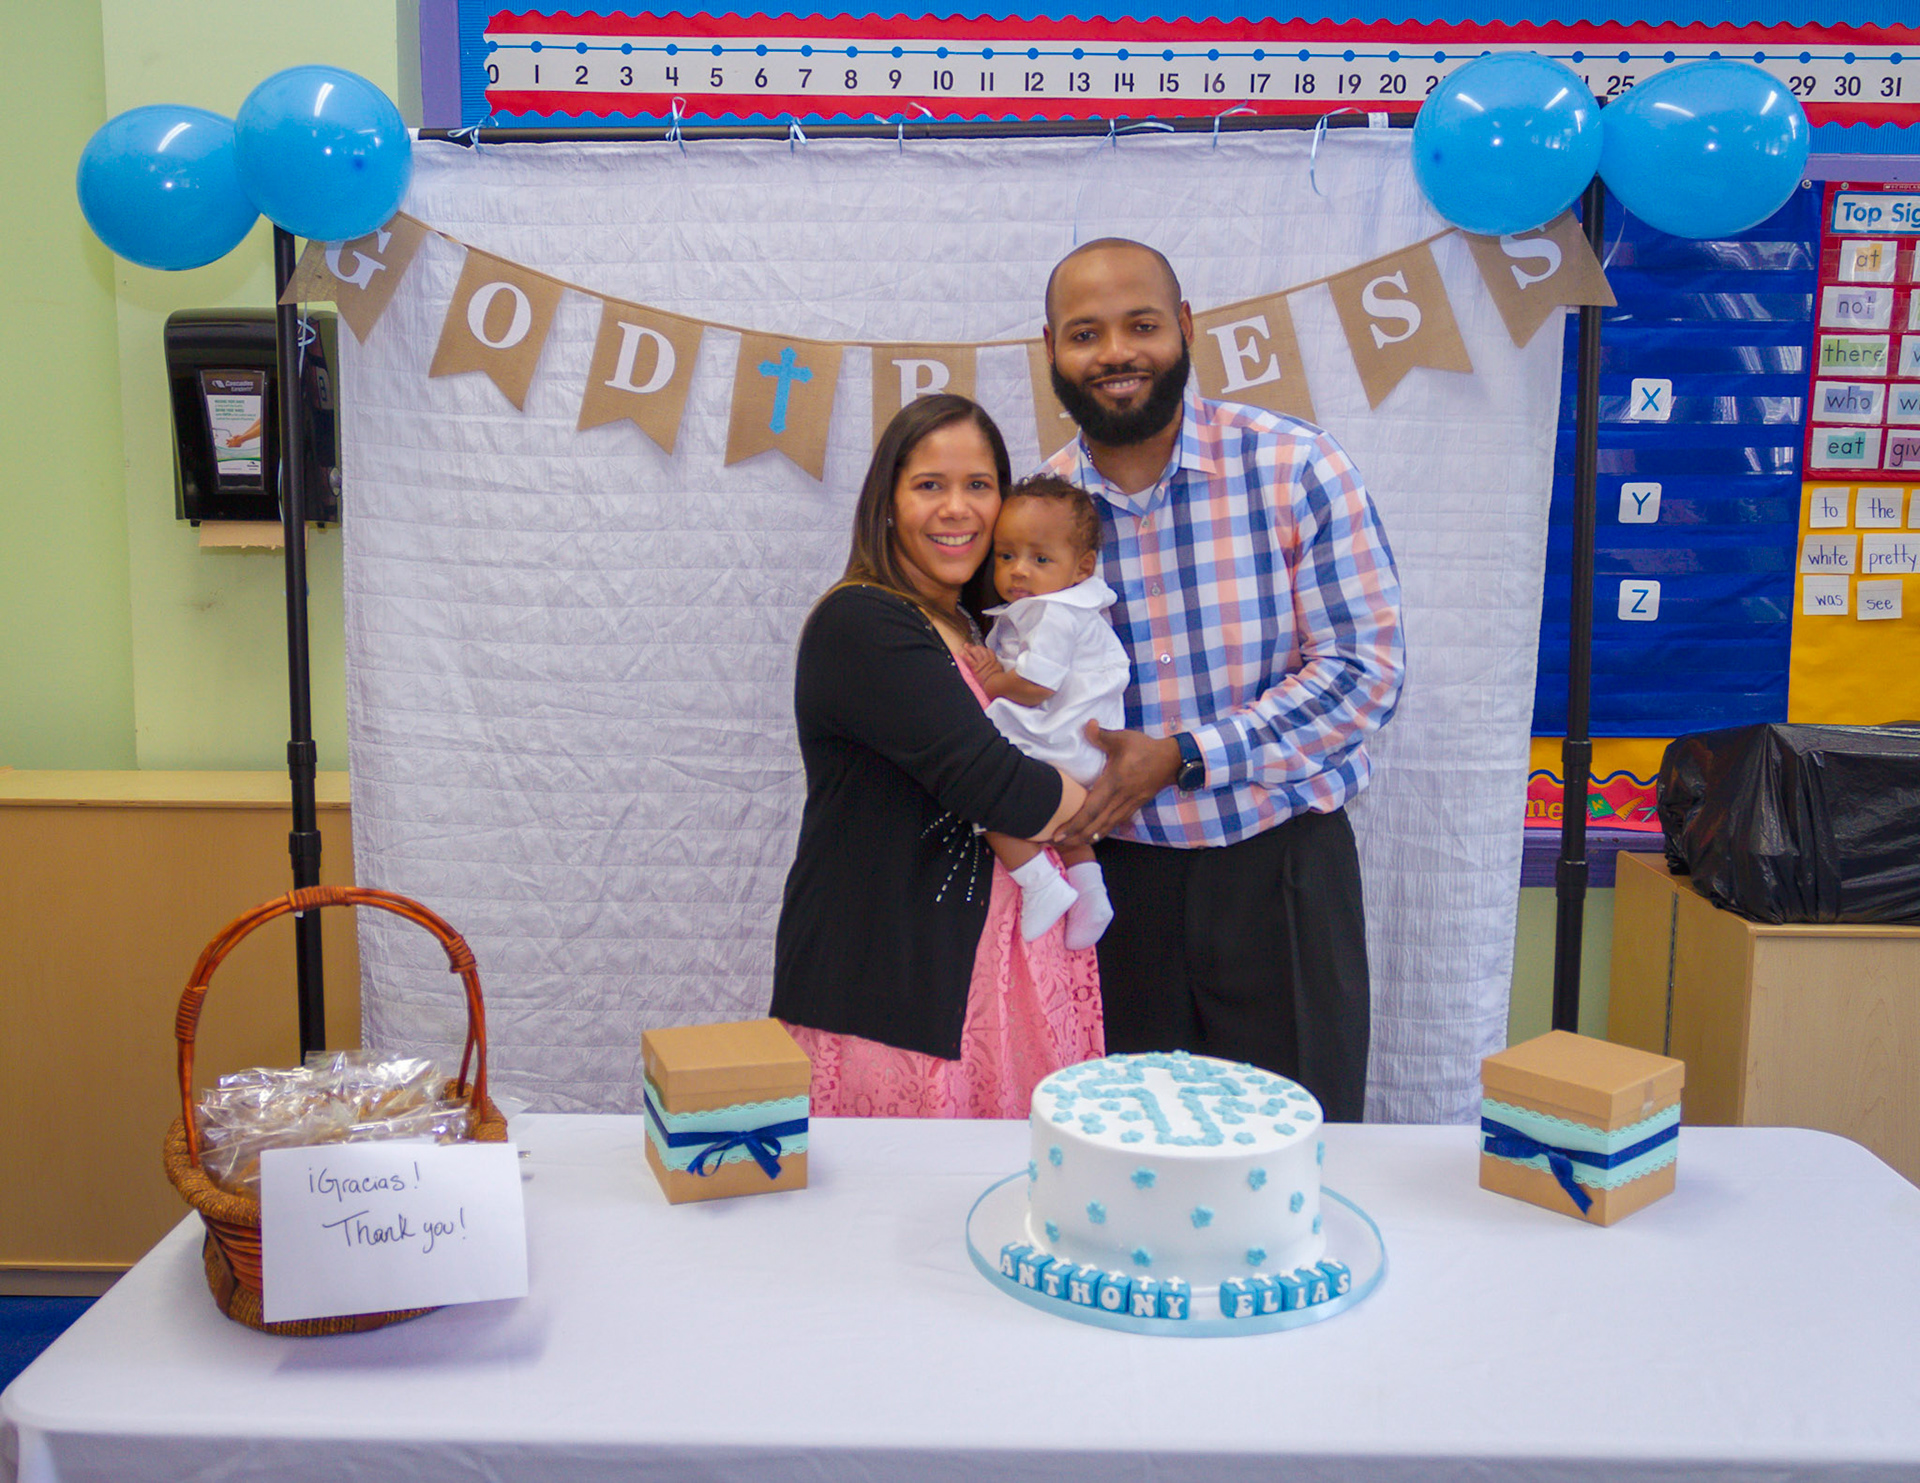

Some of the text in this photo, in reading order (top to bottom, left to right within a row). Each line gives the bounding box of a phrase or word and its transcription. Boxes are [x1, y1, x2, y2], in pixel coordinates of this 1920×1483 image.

[486, 63, 500, 85] 0
[534, 64, 540, 84] 1
[575, 65, 589, 85] 2
[619, 66, 634, 87] 3
[665, 66, 679, 87] 4
[710, 67, 723, 88] 5
[754, 67, 768, 88] 6
[798, 68, 812, 89] 7
[844, 69, 858, 90] 8
[889, 69, 902, 90] 9
[933, 70, 954, 91] 10
[980, 72, 994, 92] 11
[1025, 71, 1044, 92] 12
[1069, 72, 1091, 92] 13
[1114, 72, 1135, 93] 14
[1159, 73, 1180, 93] 15
[1204, 72, 1226, 94] 16
[1250, 73, 1271, 93] 17
[1294, 73, 1316, 94] 18
[1338, 73, 1362, 94] 19
[1379, 73, 1407, 95] 20
[1425, 75, 1447, 95] 2
[1606, 75, 1636, 96] 25
[1788, 75, 1817, 96] 29
[1833, 75, 1862, 97] 30
[1880, 76, 1903, 98] 31
[1842, 201, 1883, 227] Top
[1856, 249, 1880, 268] at
[1839, 296, 1875, 315] not
[891, 224, 1562, 419] BESS
[1824, 339, 1885, 362] there
[1640, 386, 1662, 412] X
[1826, 386, 1871, 410] who
[1828, 437, 1864, 455] eat
[1631, 491, 1652, 516] Y
[1821, 496, 1839, 518] to
[1867, 497, 1896, 519] the
[1807, 544, 1849, 566] white
[1869, 543, 1917, 573] pretty
[1630, 589, 1650, 614] Z
[1815, 594, 1844, 607] was
[1866, 598, 1894, 611] see
[321, 1206, 467, 1255] Thank you!
[1000, 1253, 1350, 1319] ANTHONY ELIAS
